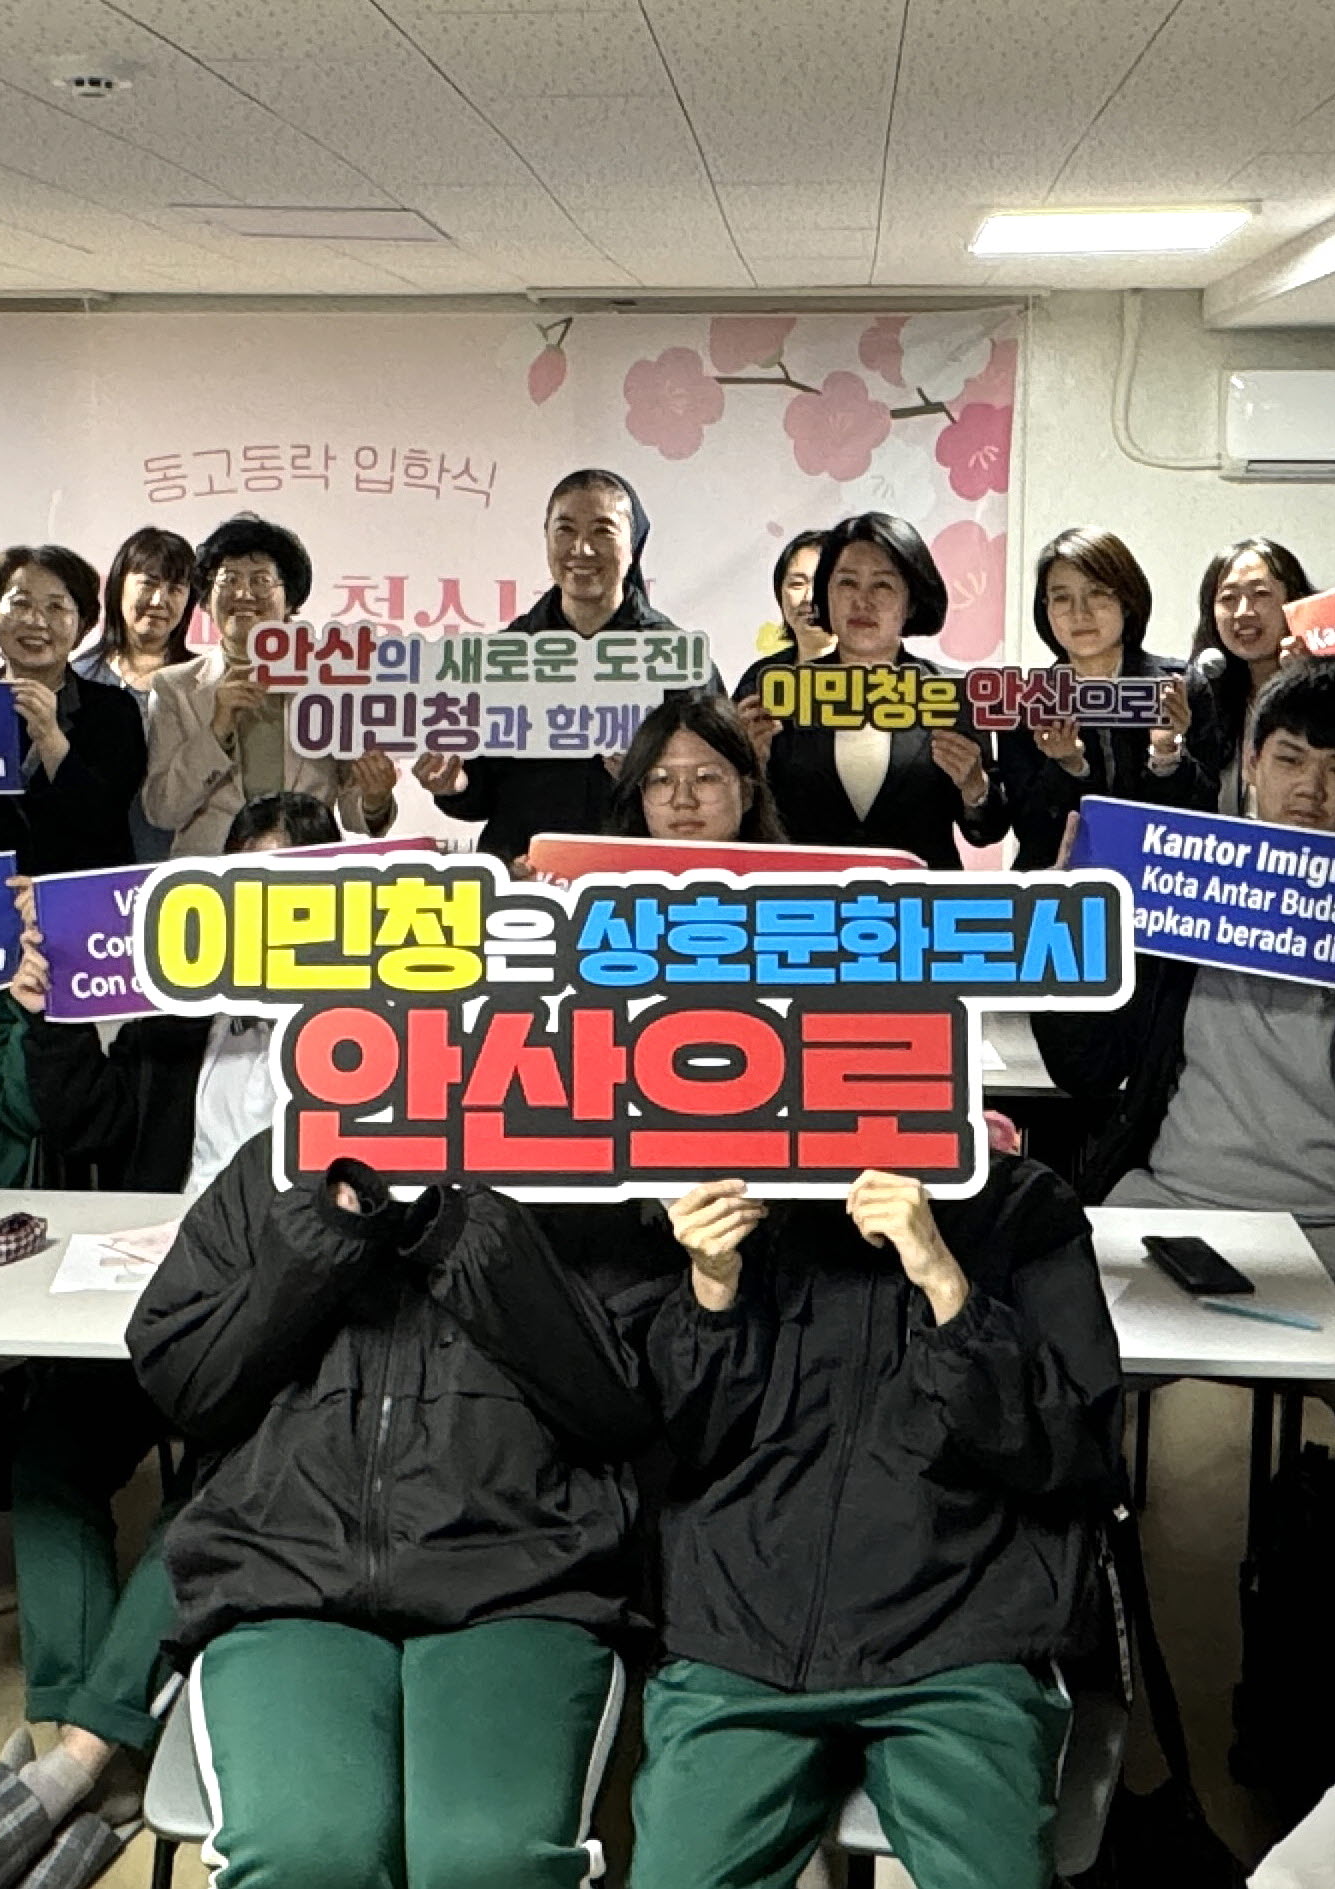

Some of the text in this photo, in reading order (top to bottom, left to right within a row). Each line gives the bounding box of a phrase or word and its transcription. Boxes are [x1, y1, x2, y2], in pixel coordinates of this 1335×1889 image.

[143, 443, 498, 507] 동고동락 입학식
[253, 626, 705, 686] 안산의 새로운 도전!
[296, 692, 532, 753] 이민청과
[763, 668, 961, 729] 이민청은
[1142, 823, 1252, 867] Kantor
[1141, 865, 1199, 901] Kota
[1203, 876, 1277, 913] Antar
[158, 877, 1106, 992] 이민청은 상호문화도시
[1216, 916, 1306, 959] berada
[71, 972, 127, 999] Con
[293, 1002, 961, 1175] 안산으로
